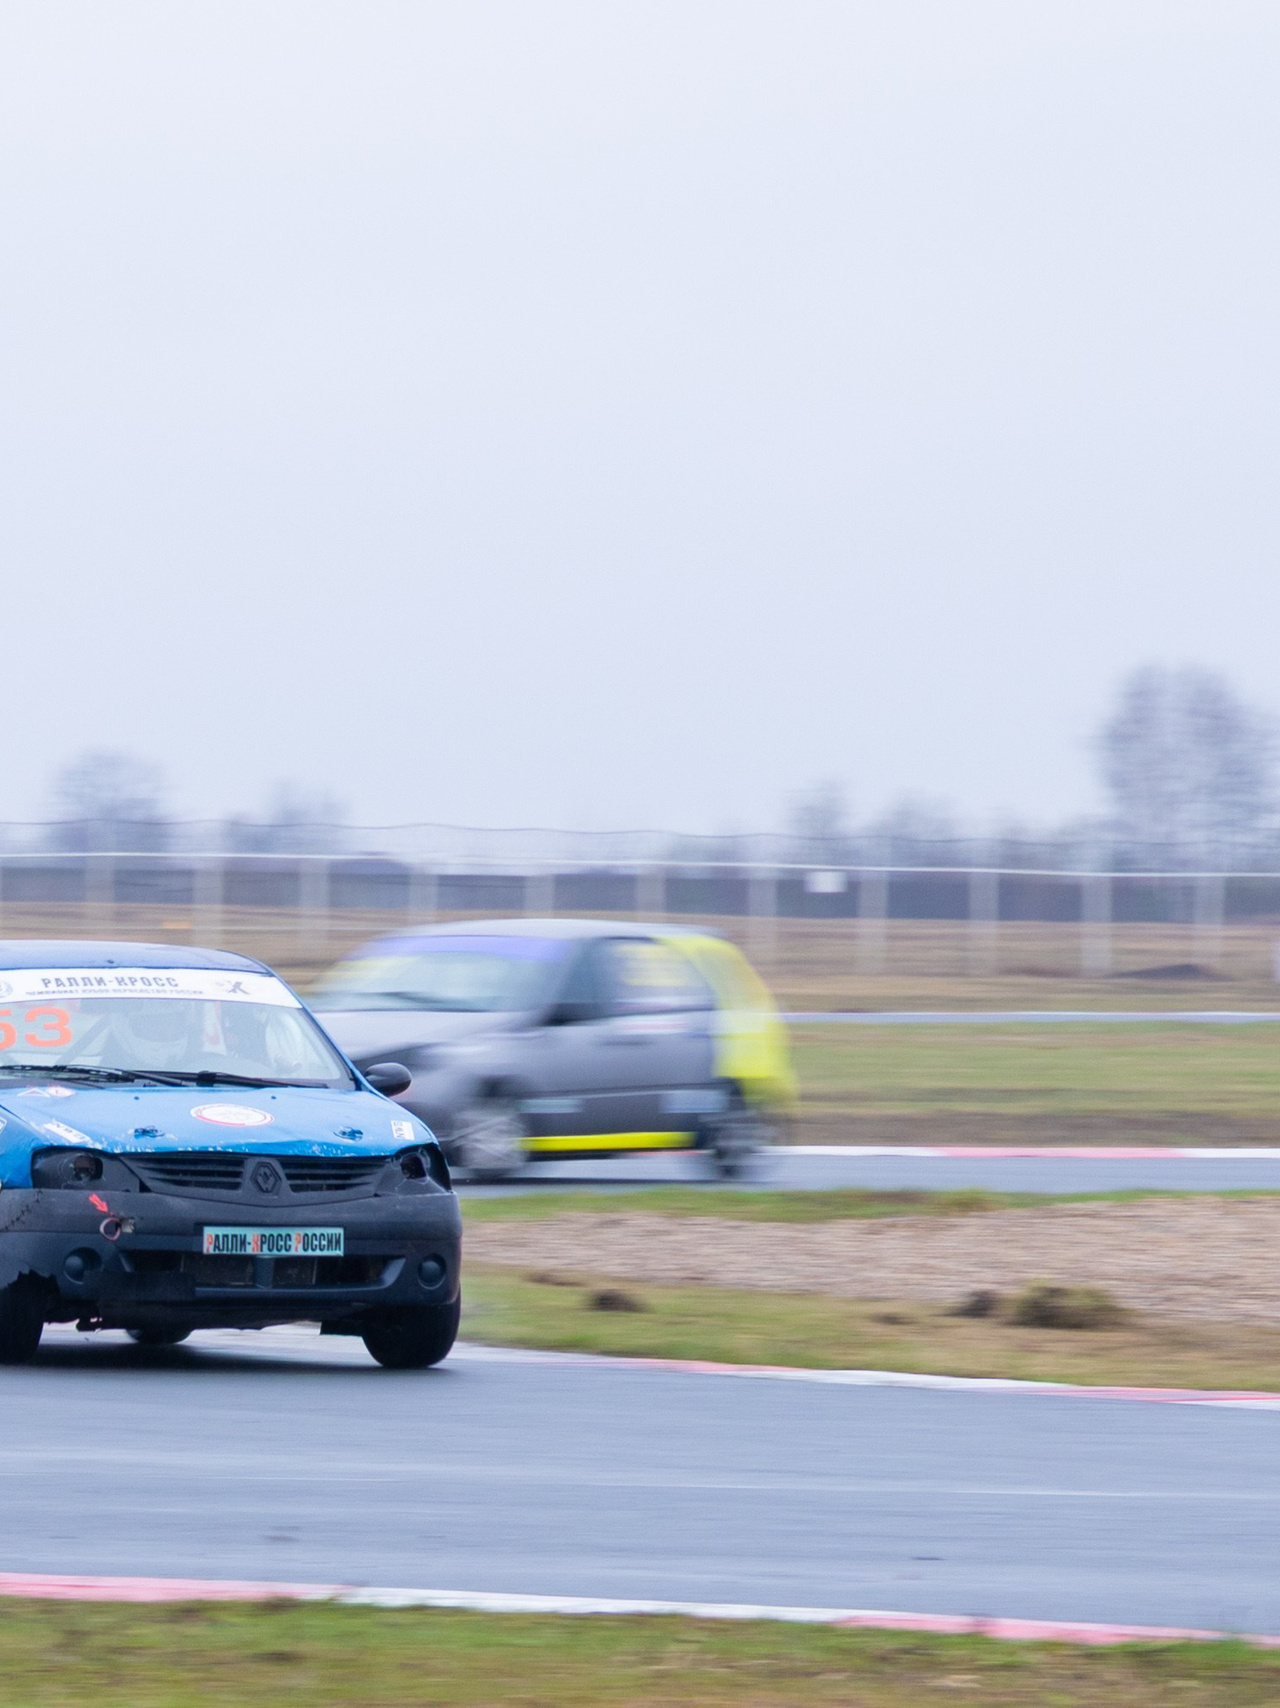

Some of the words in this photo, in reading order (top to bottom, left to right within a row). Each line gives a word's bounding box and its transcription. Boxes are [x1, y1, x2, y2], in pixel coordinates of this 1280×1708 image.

[41, 976, 179, 988] РАЛЛИ-КРОСС
[206, 1233, 292, 1253] РАЛЛИ-КРОСС
[294, 1232, 342, 1252] РОССИИ
